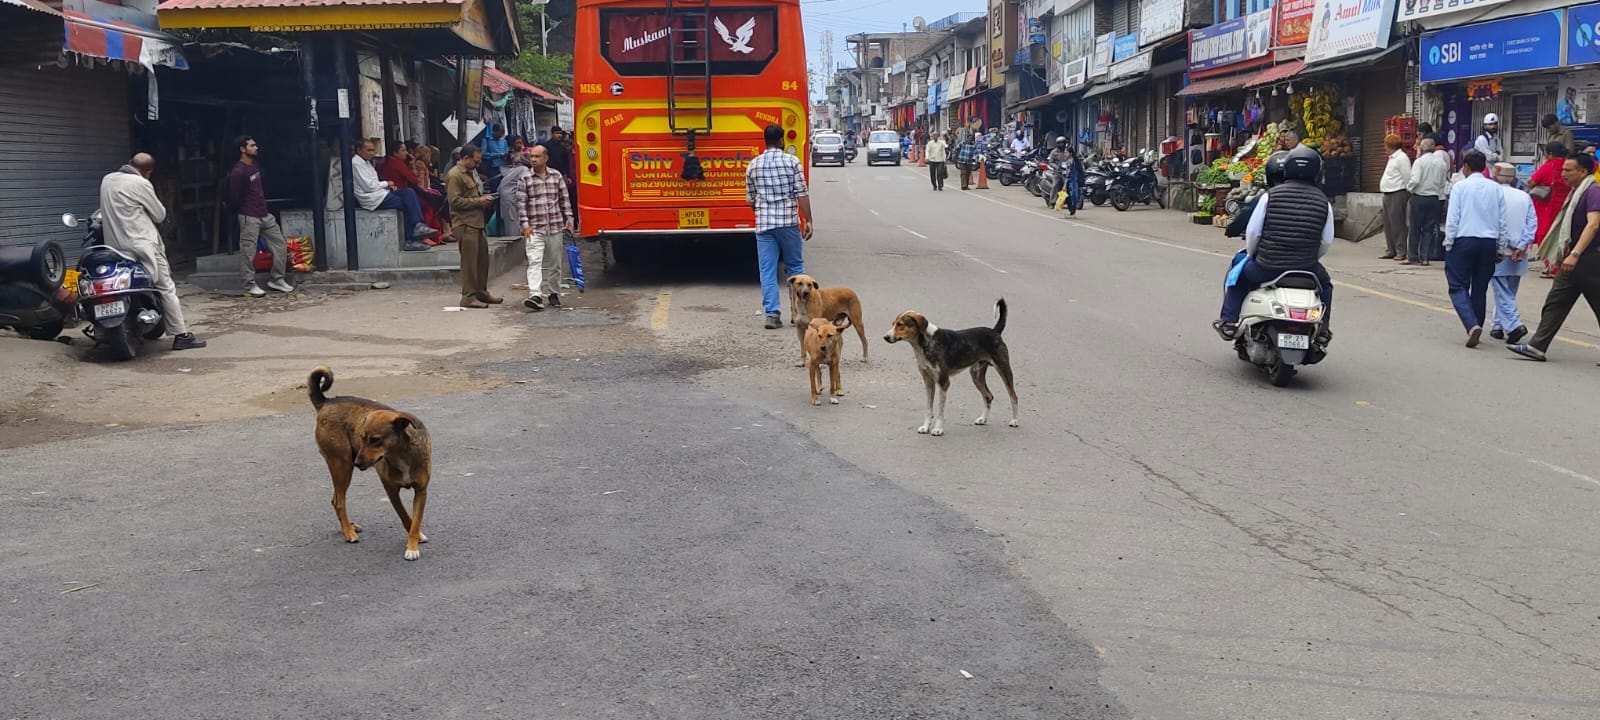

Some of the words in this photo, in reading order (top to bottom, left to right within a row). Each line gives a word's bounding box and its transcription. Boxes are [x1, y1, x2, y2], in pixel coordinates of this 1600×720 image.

[621, 26, 671, 53] Muskaan
[1441, 41, 1461, 64] SBI
[580, 83, 602, 94] MISS
[781, 80, 798, 91] 84
[604, 113, 624, 127] RANI
[630, 153, 673, 170] Shiv
[634, 171, 678, 179] CONTACT
